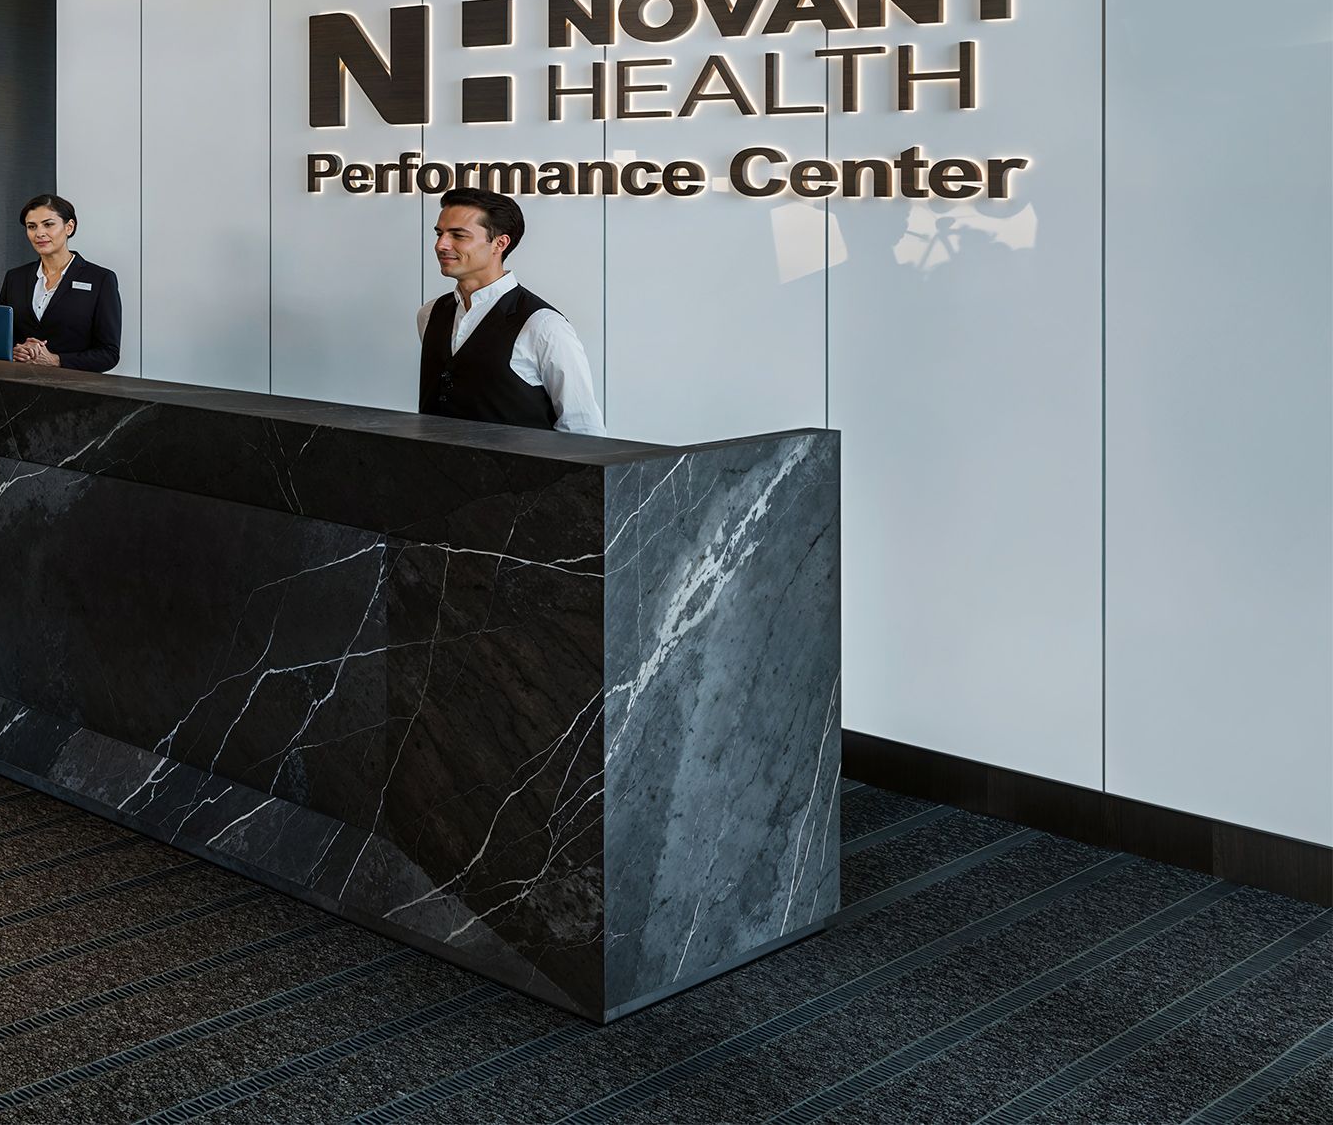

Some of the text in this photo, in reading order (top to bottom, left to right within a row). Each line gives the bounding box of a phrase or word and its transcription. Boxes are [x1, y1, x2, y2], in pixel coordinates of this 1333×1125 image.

[547, 41, 976, 121] HEALTH
[307, 145, 1029, 199] Performance Center
